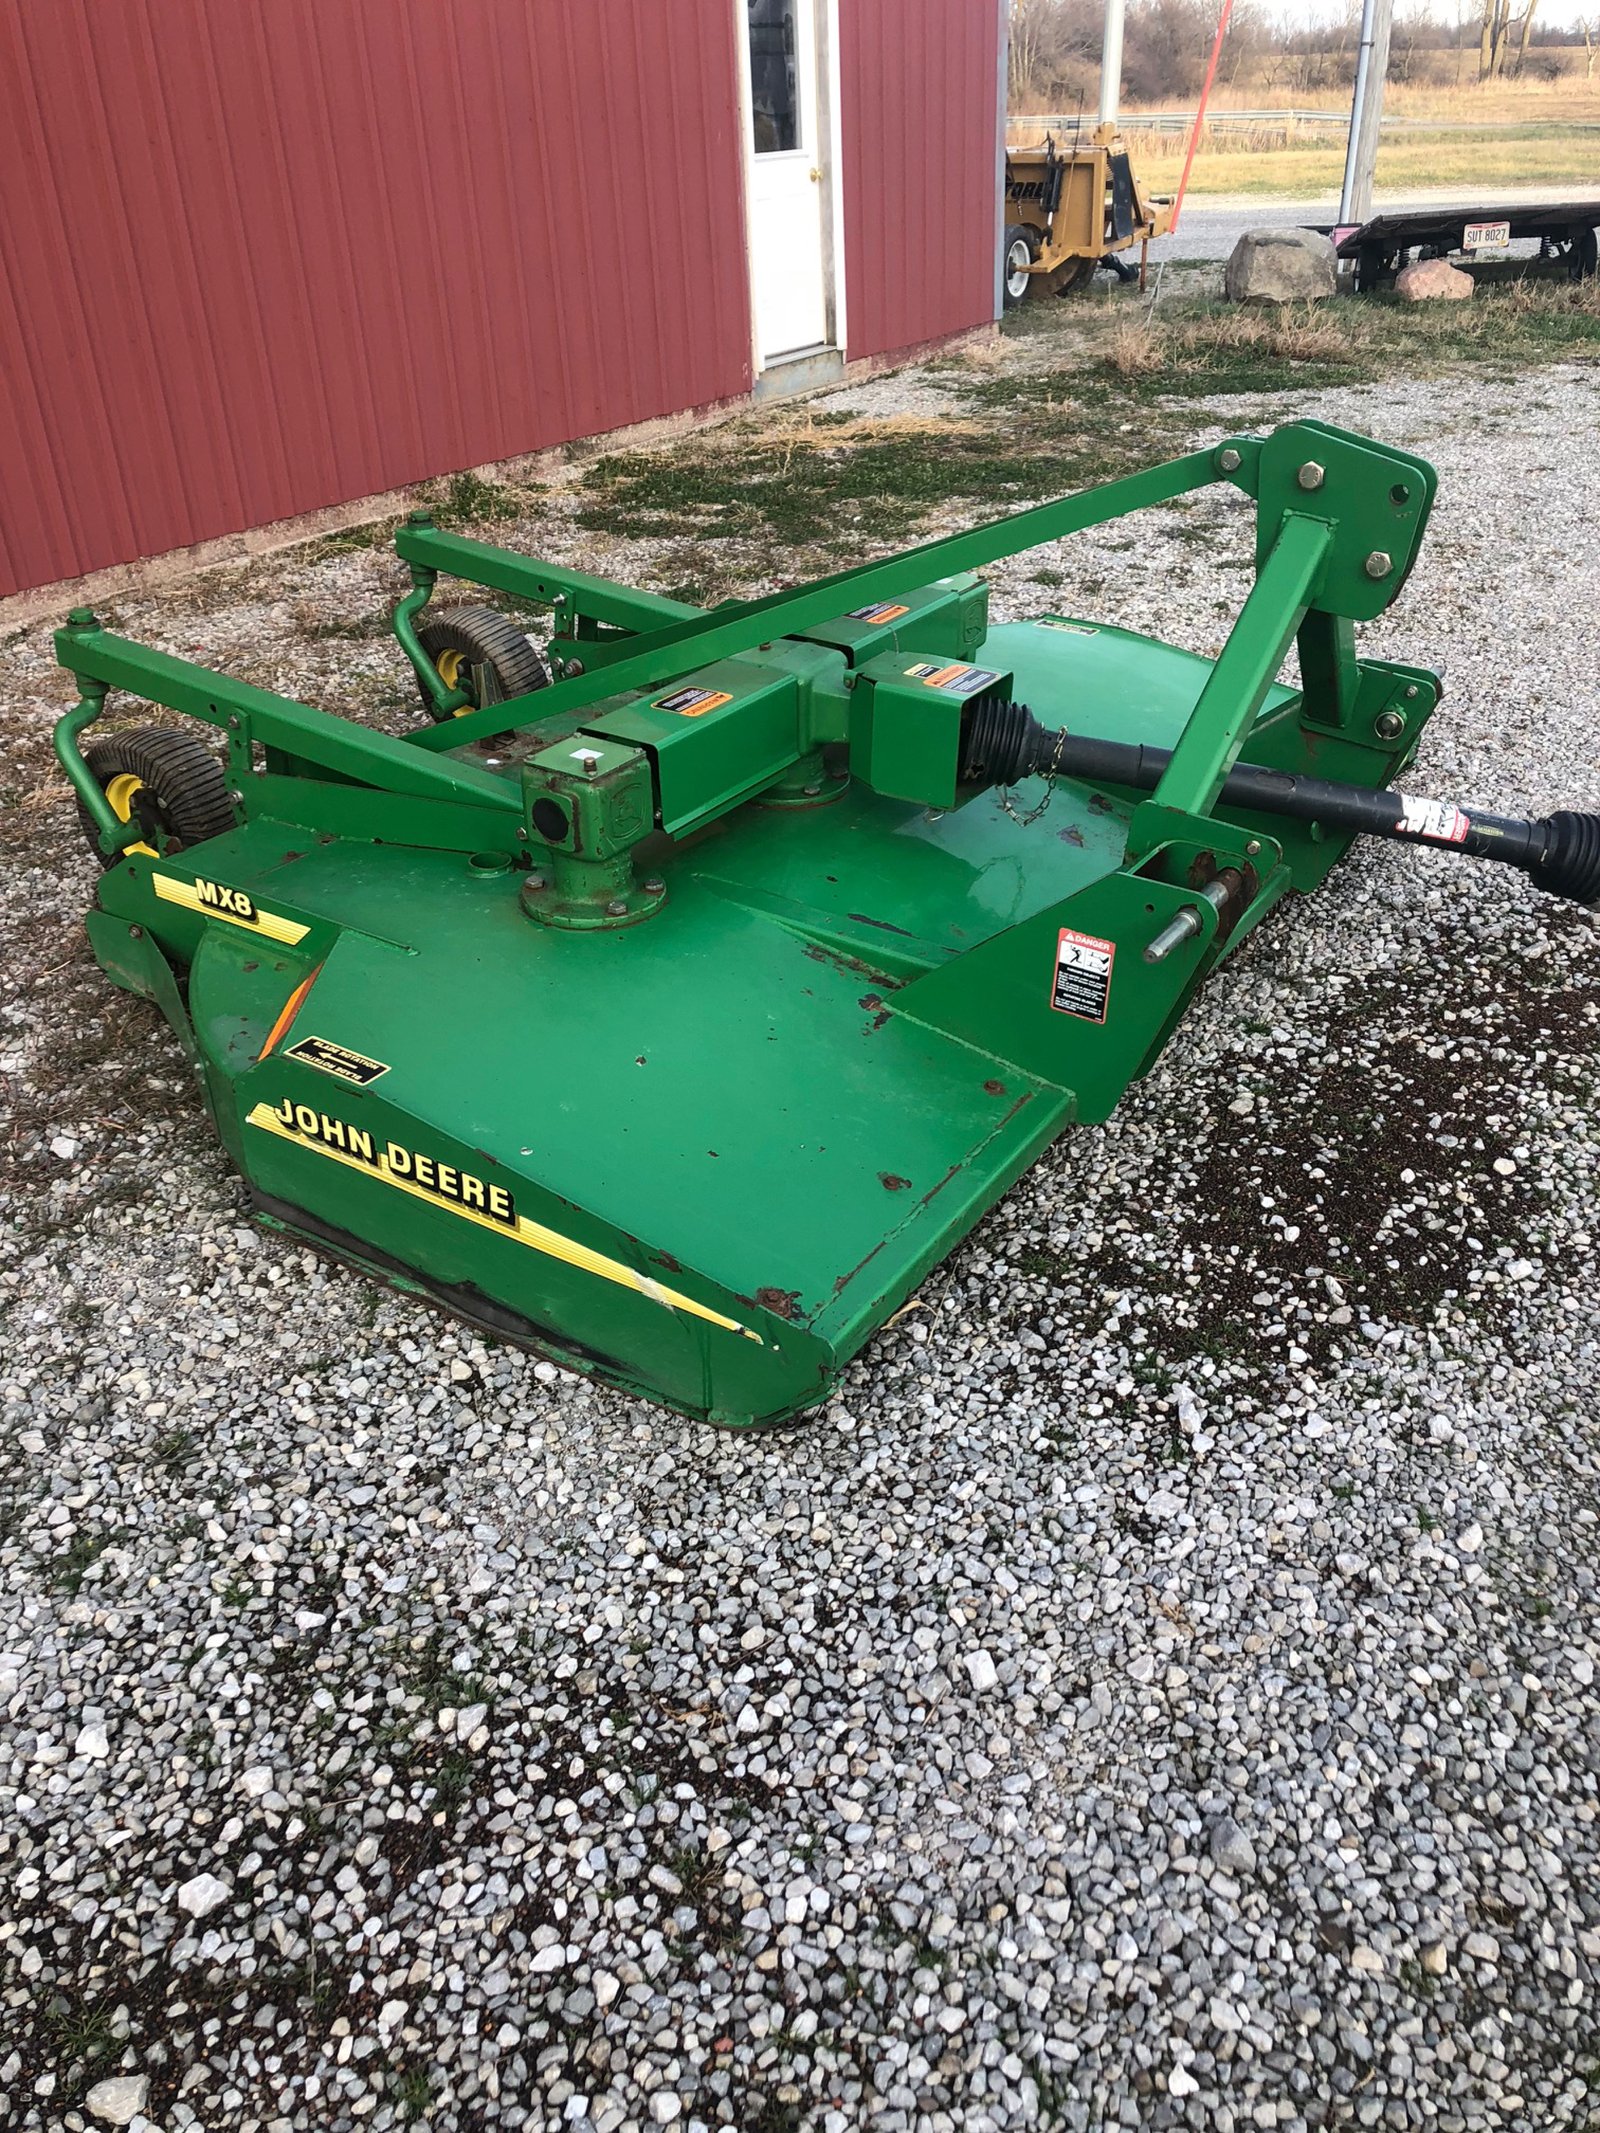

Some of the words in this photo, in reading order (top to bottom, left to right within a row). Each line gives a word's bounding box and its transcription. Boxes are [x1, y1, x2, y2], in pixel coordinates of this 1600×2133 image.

[1467, 230, 1483, 243] SUT
[1485, 229, 1506, 241] 8027
[195, 877, 254, 918] MX8
[1075, 935, 1110, 950] DANGER
[295, 1051, 336, 1069] ROTATION
[313, 1041, 340, 1054] BLADE
[338, 1051, 380, 1070] ROTATION
[334, 1066, 363, 1081] BLADE
[274, 1098, 375, 1161] JOHN
[387, 1141, 512, 1219] DEERE
